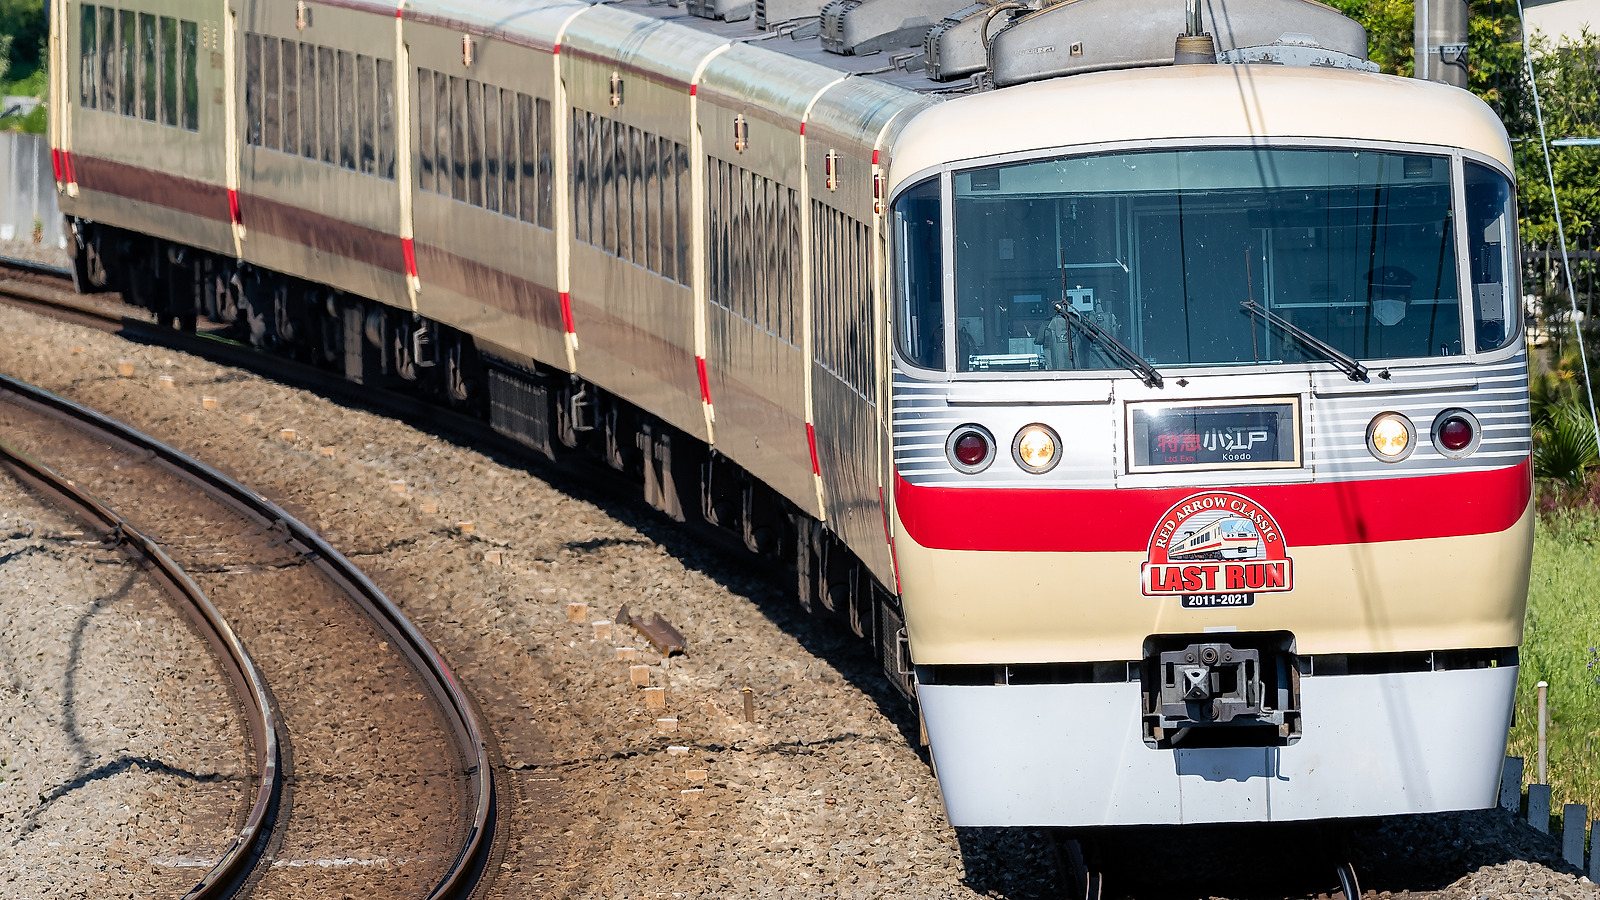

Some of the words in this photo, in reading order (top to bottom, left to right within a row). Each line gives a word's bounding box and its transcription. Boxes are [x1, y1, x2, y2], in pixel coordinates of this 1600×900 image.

[1158, 432, 1202, 452] 特急
[1203, 426, 1268, 451] 小江戸
[1222, 452, 1251, 461] Koedo
[1156, 520, 1177, 549] RED
[1176, 497, 1228, 522] ARROW
[1230, 499, 1278, 543] CLASSIC
[1150, 565, 1219, 592] LAST
[1225, 563, 1285, 590] RUN
[1188, 593, 1248, 606] 2011-2021
